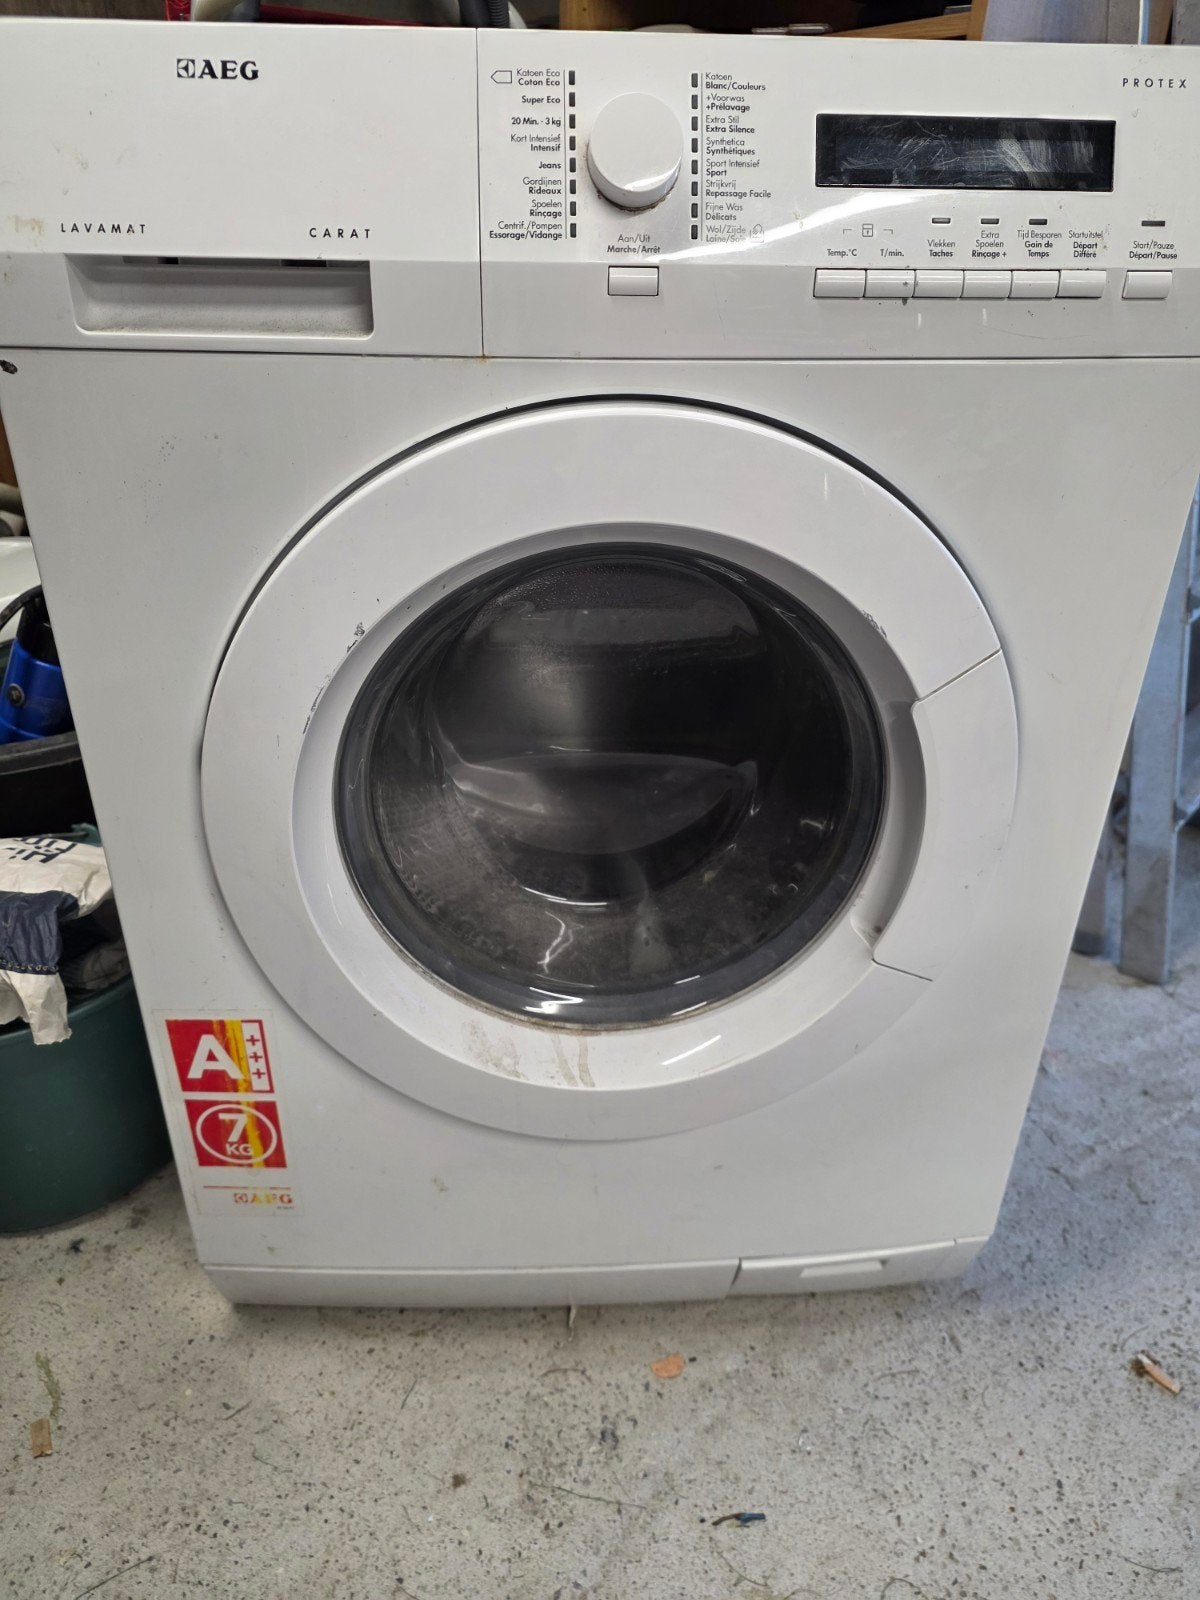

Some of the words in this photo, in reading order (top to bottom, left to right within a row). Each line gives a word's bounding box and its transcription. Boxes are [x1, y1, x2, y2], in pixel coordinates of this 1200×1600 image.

[198, 59, 259, 80] AEG
[517, 69, 543, 77] Katoen
[546, 69, 561, 77] Eco
[705, 72, 733, 81] Katoen
[518, 78, 543, 86] Coton
[546, 78, 561, 86] Eco
[705, 82, 767, 91] Blanc/Couleurs
[1122, 78, 1186, 88] PROTEX
[521, 95, 544, 105] Super
[546, 96, 561, 104] Eco
[705, 93, 745, 102] +Voorwas
[705, 102, 751, 113] +Prélavage
[511, 117, 521, 125] 20
[522, 117, 539, 125] Min.
[545, 117, 550, 125] 3
[551, 117, 561, 128] kg
[705, 115, 726, 124] Extra
[728, 115, 740, 124] Stil
[705, 125, 727, 133] Extra
[728, 125, 756, 134] Silence
[510, 133, 527, 142] Kort
[529, 133, 561, 142] Intensief
[705, 136, 746, 147] Synthetica
[530, 143, 561, 152] Intensif
[706, 146, 756, 157] Synthétiques
[538, 161, 562, 170] Jeans
[705, 158, 727, 169] Sport
[728, 159, 761, 168] Intensief
[705, 168, 727, 178] Sport
[522, 176, 562, 187] Gordijnen
[705, 179, 737, 190] Strijkvrij
[528, 186, 562, 195] Rideaux
[705, 189, 748, 199] Repassage
[749, 190, 772, 199] Facile
[531, 199, 563, 209] Spoelen
[705, 202, 724, 212] Fijne
[725, 203, 744, 212] Was
[529, 209, 563, 219] Rinçage
[705, 212, 737, 221] Délicats
[60, 222, 147, 235] LAVAMAT
[497, 220, 563, 231] Centrif./Pompen
[705, 224, 746, 235] Wol/Zijde
[309, 227, 372, 239] CARAT
[489, 230, 563, 241] Essorage/Vidange
[980, 230, 1000, 239] Extra
[1017, 230, 1030, 240] Tijd
[1031, 230, 1062, 240] Besparen
[1068, 230, 1104, 239] Startuitstel
[617, 234, 651, 243] Aan/Uit
[927, 239, 956, 248] Vlekken
[606, 244, 661, 254] Marche/Arrêt
[975, 239, 1004, 249] Spoelen
[1024, 240, 1043, 249] Gain
[1044, 240, 1053, 248] de
[1073, 242, 1098, 250] Départ
[1132, 240, 1175, 250] Start/Pauze
[880, 248, 905, 257] T/min.
[929, 249, 954, 258] Taches
[971, 249, 1000, 259] Rinçage
[1027, 250, 1050, 259] Temps
[1073, 250, 1097, 259] Différé
[1129, 250, 1178, 260] Départ/Pause
[218, 1112, 248, 1142] 7
[226, 1143, 254, 1156] KG
